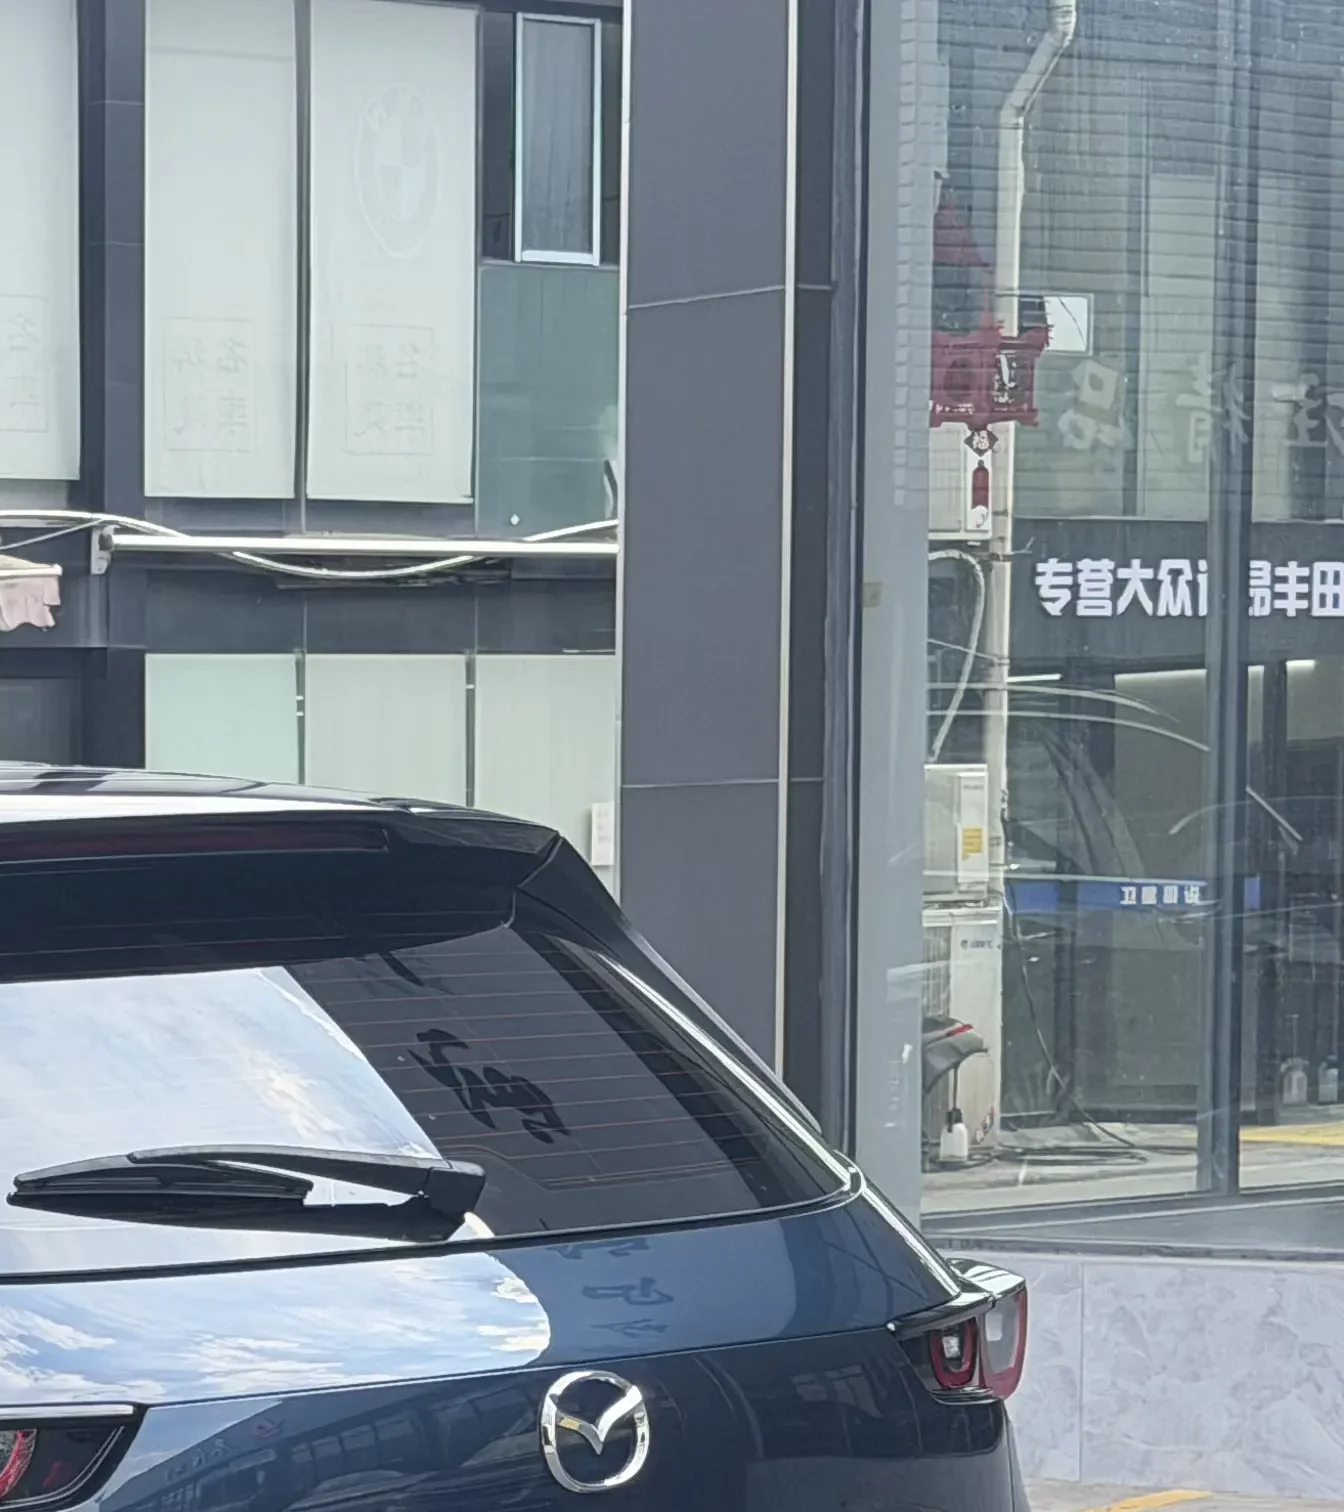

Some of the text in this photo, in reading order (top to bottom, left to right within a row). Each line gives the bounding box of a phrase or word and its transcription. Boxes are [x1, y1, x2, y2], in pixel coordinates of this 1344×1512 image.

[1035, 557, 1344, 617] 专营大众昂丰田
